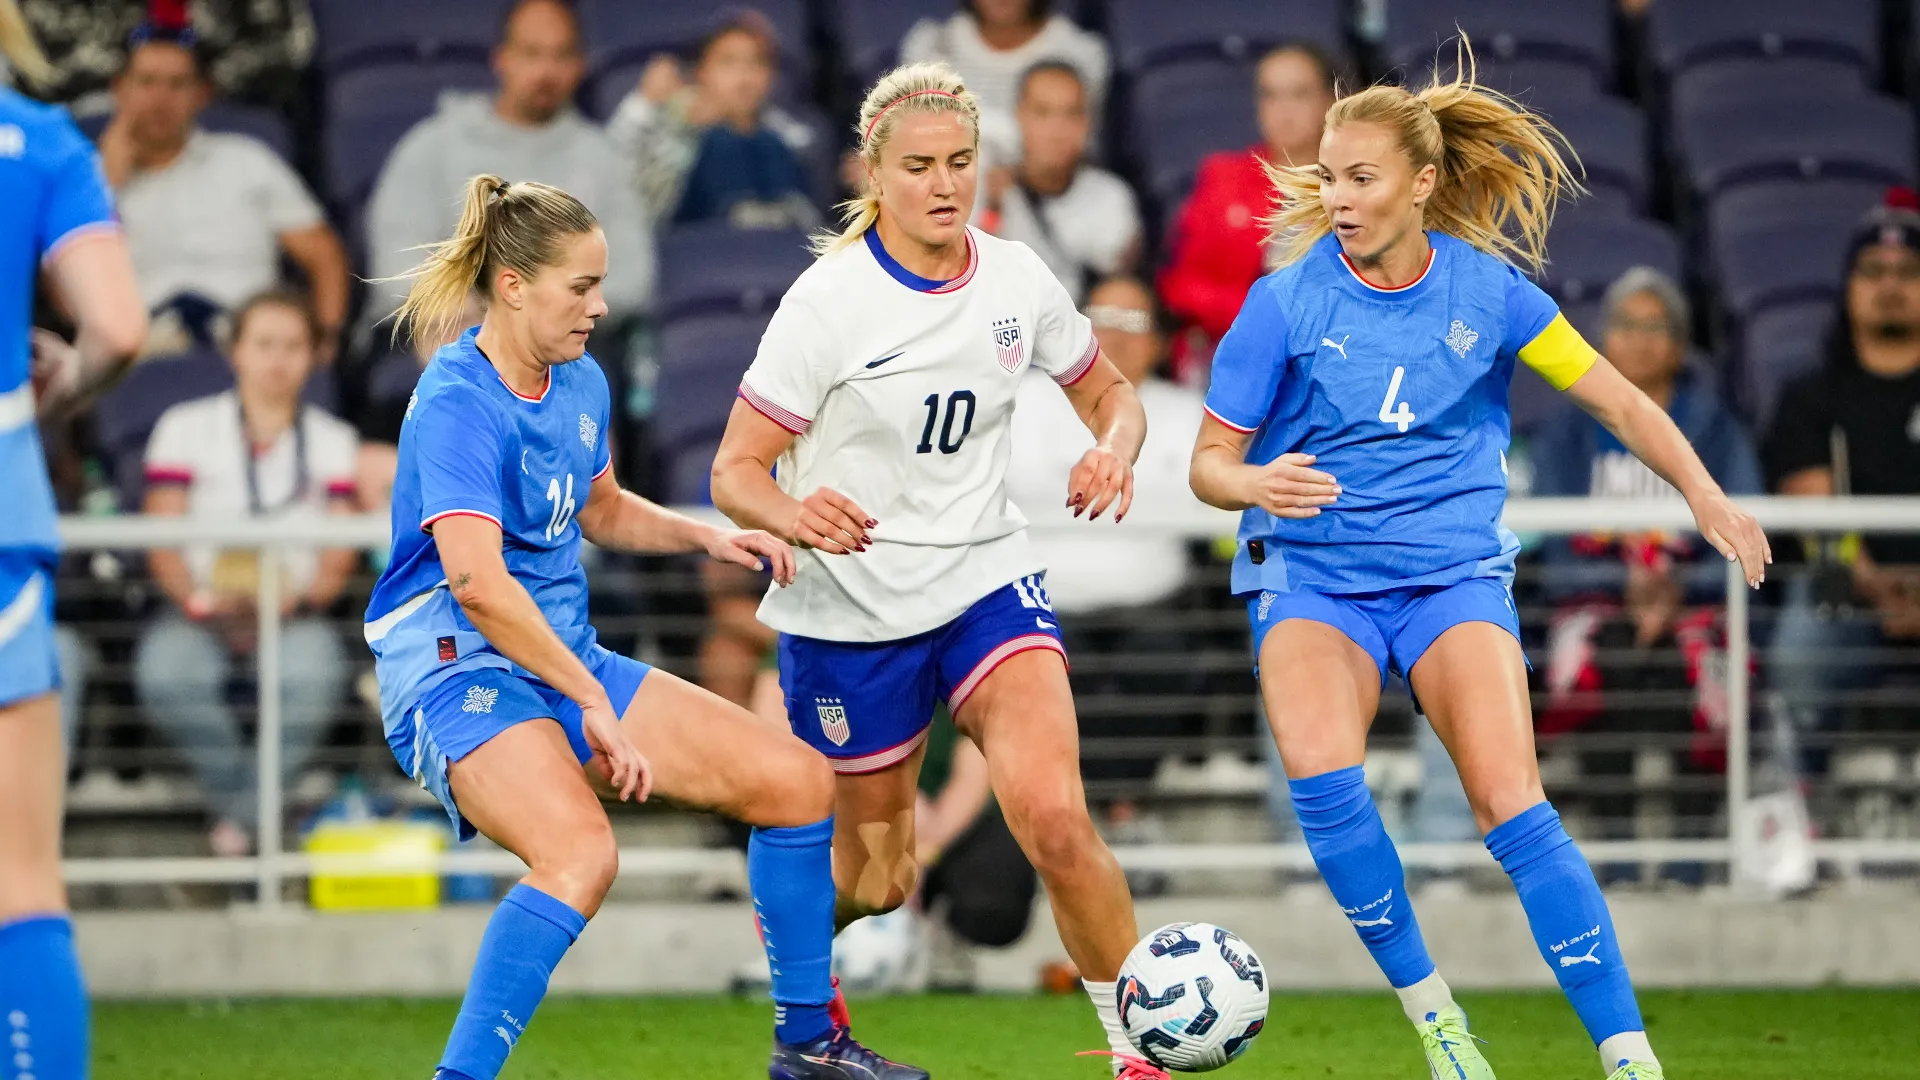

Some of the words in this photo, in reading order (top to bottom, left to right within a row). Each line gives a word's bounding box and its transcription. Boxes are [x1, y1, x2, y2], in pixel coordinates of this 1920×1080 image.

[995, 329, 1019, 347] USA
[916, 390, 976, 454] 10
[1379, 366, 1415, 432] 4
[546, 473, 575, 541] 16
[1013, 575, 1052, 613] 10
[819, 708, 843, 724] USA
